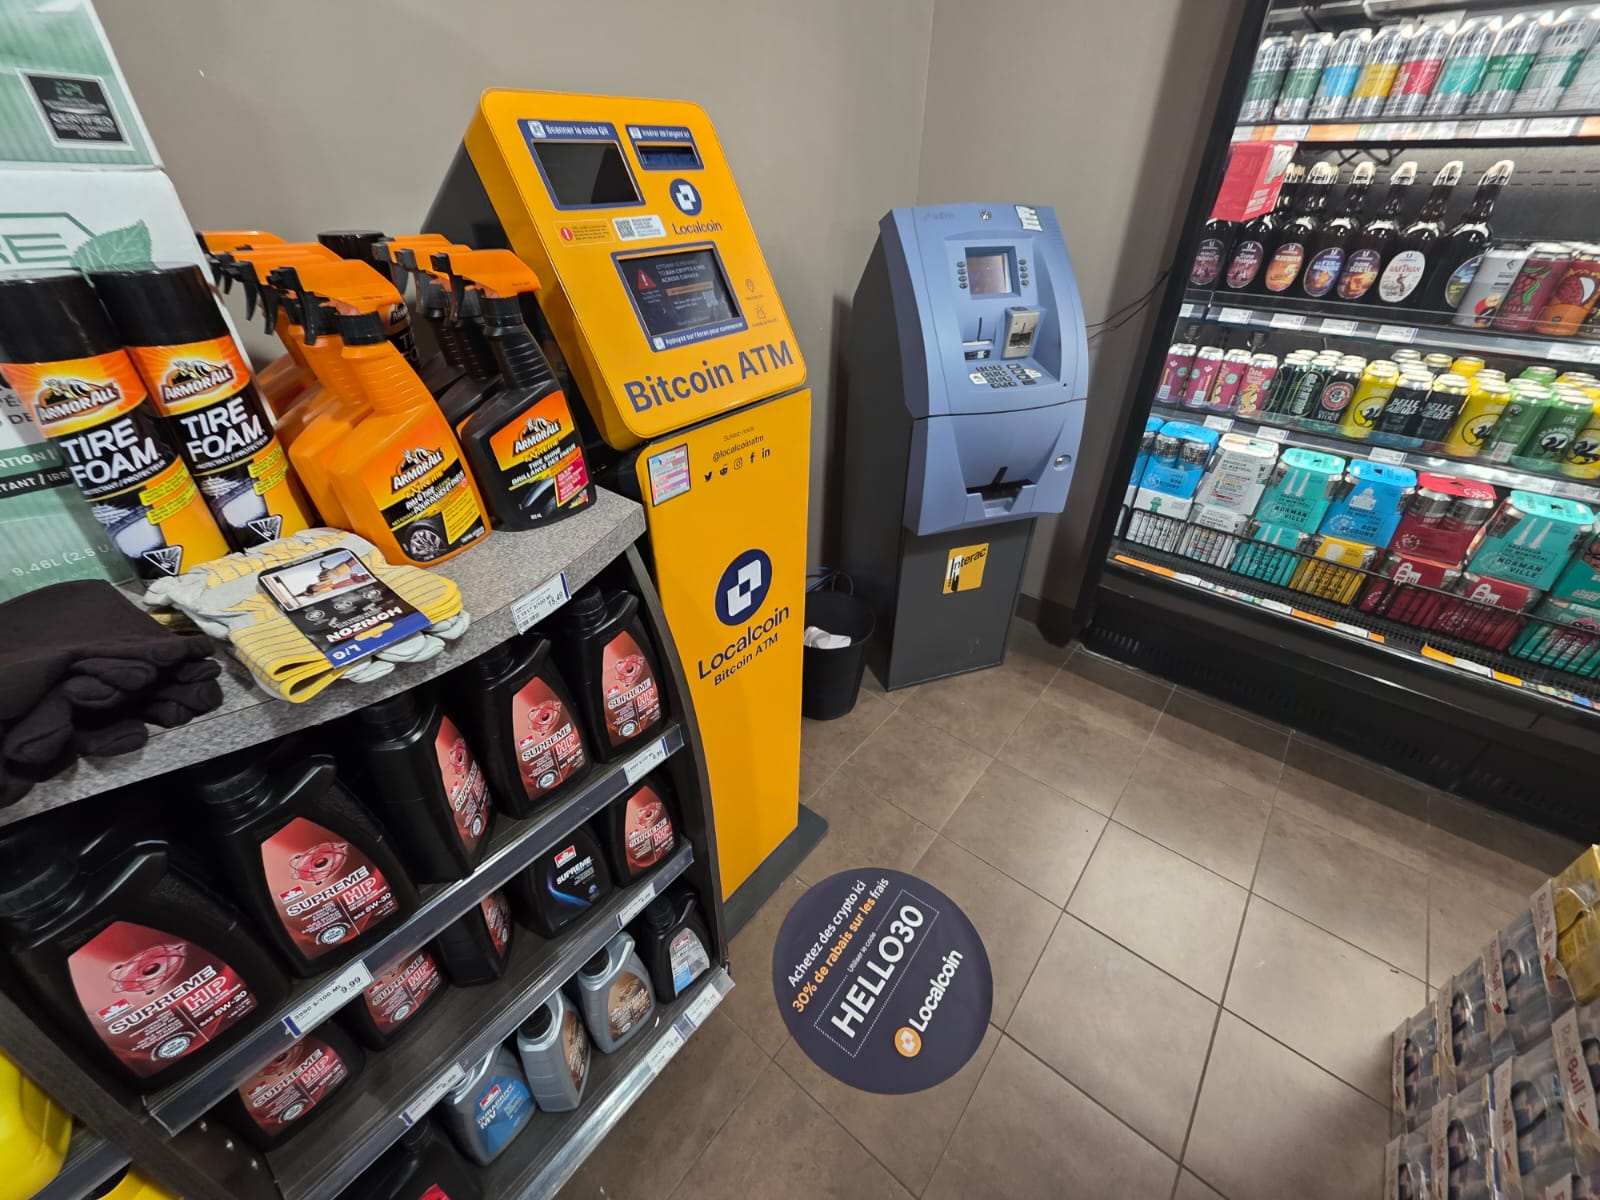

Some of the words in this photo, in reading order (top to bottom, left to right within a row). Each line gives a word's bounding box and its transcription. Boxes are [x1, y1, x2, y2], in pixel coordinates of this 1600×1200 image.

[672, 220, 723, 235] Localcoin
[624, 360, 734, 413] Bitcoin
[738, 340, 794, 380] ATM
[180, 397, 248, 439] TIRE
[186, 414, 262, 462] FOAM
[60, 418, 138, 463] TIRE
[70, 437, 158, 487] FOAM
[12, 559, 61, 577] 9.46L
[62, 547, 95, 565] (2.5
[950, 548, 986, 578] Interac
[1497, 558, 1542, 573] NORMAN
[1509, 567, 1538, 578] VILLE
[326, 606, 403, 643] HORIZON
[698, 606, 790, 680] Localcoin
[332, 644, 362, 660] L/G
[714, 652, 753, 687] Bitcoin
[755, 632, 779, 658] ATM
[521, 722, 572, 762] SUPREME
[555, 734, 575, 755] HP
[556, 855, 592, 885] SUPREME
[286, 865, 370, 917] SUPREME
[342, 877, 376, 905] HP
[788, 942, 823, 988] Achetez
[819, 924, 836, 944] des
[832, 892, 858, 927] crypto
[854, 880, 867, 895] ici
[792, 980, 818, 1013] 30%
[814, 965, 829, 984] de
[826, 930, 853, 967] rabais
[850, 914, 864, 932] sur
[859, 897, 876, 915] les
[869, 877, 889, 900] frais
[341, 976, 361, 993] 9.99
[372, 954, 424, 1006] SUPREME
[831, 905, 924, 1039] HELLO30
[908, 949, 963, 1033] Localcoin
[108, 964, 217, 1035] SUPREME
[183, 976, 227, 1012] HP
[253, 1048, 323, 1108] SUPREME
[301, 1055, 329, 1084] HP
[1568, 1057, 1586, 1095] Bull
